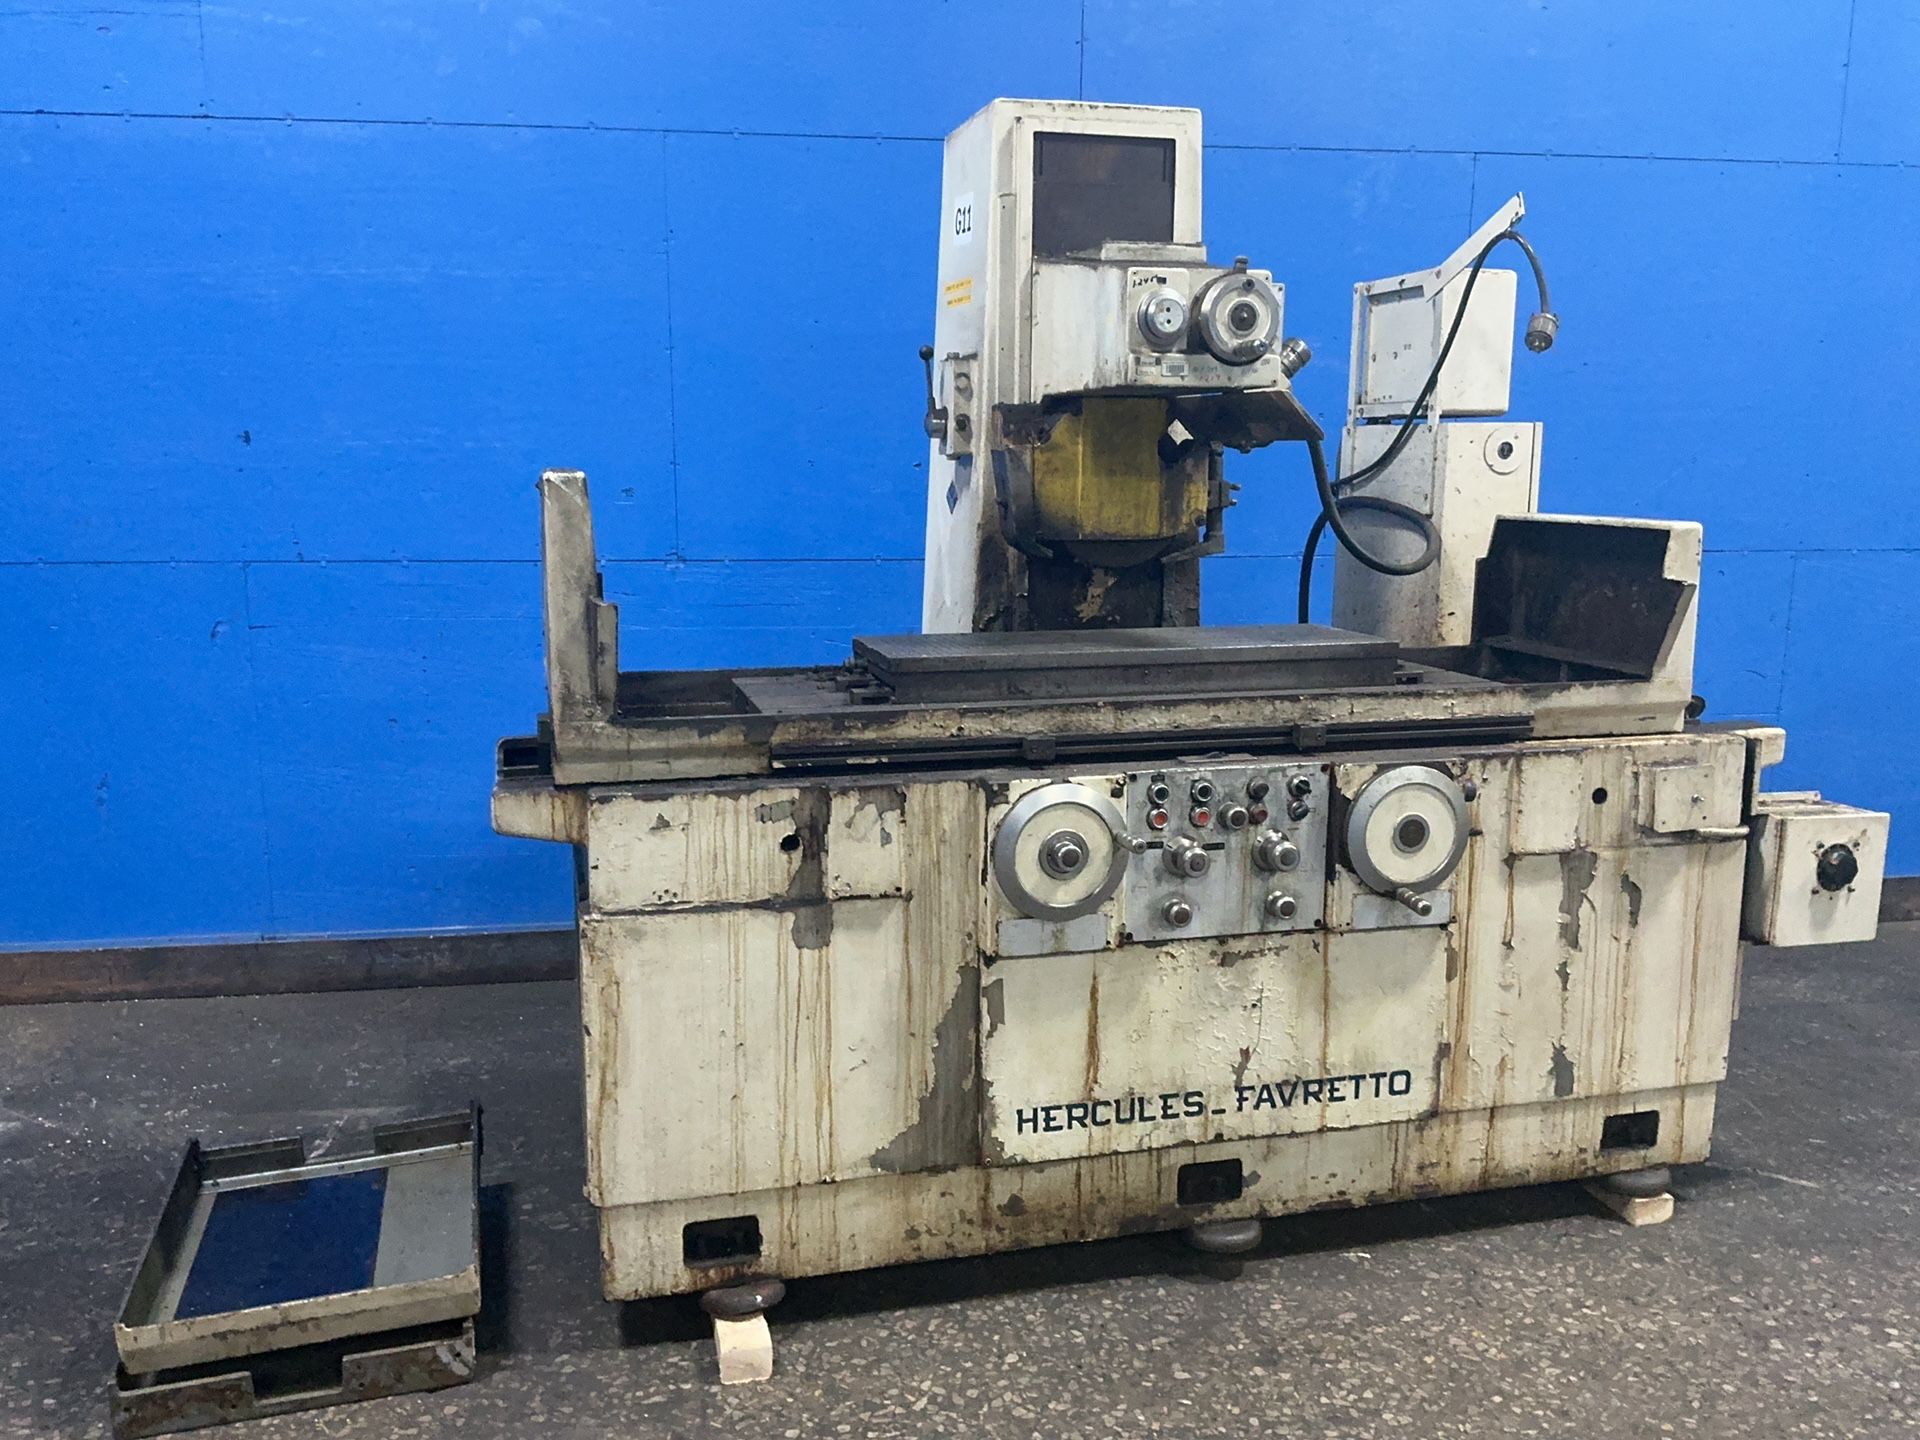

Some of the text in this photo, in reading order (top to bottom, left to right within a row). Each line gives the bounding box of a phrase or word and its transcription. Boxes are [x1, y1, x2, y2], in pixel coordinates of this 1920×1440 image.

[955, 205, 972, 236] G11
[1016, 1091, 1204, 1135] HERCULES
[1235, 1069, 1412, 1112] FAVRETTO
